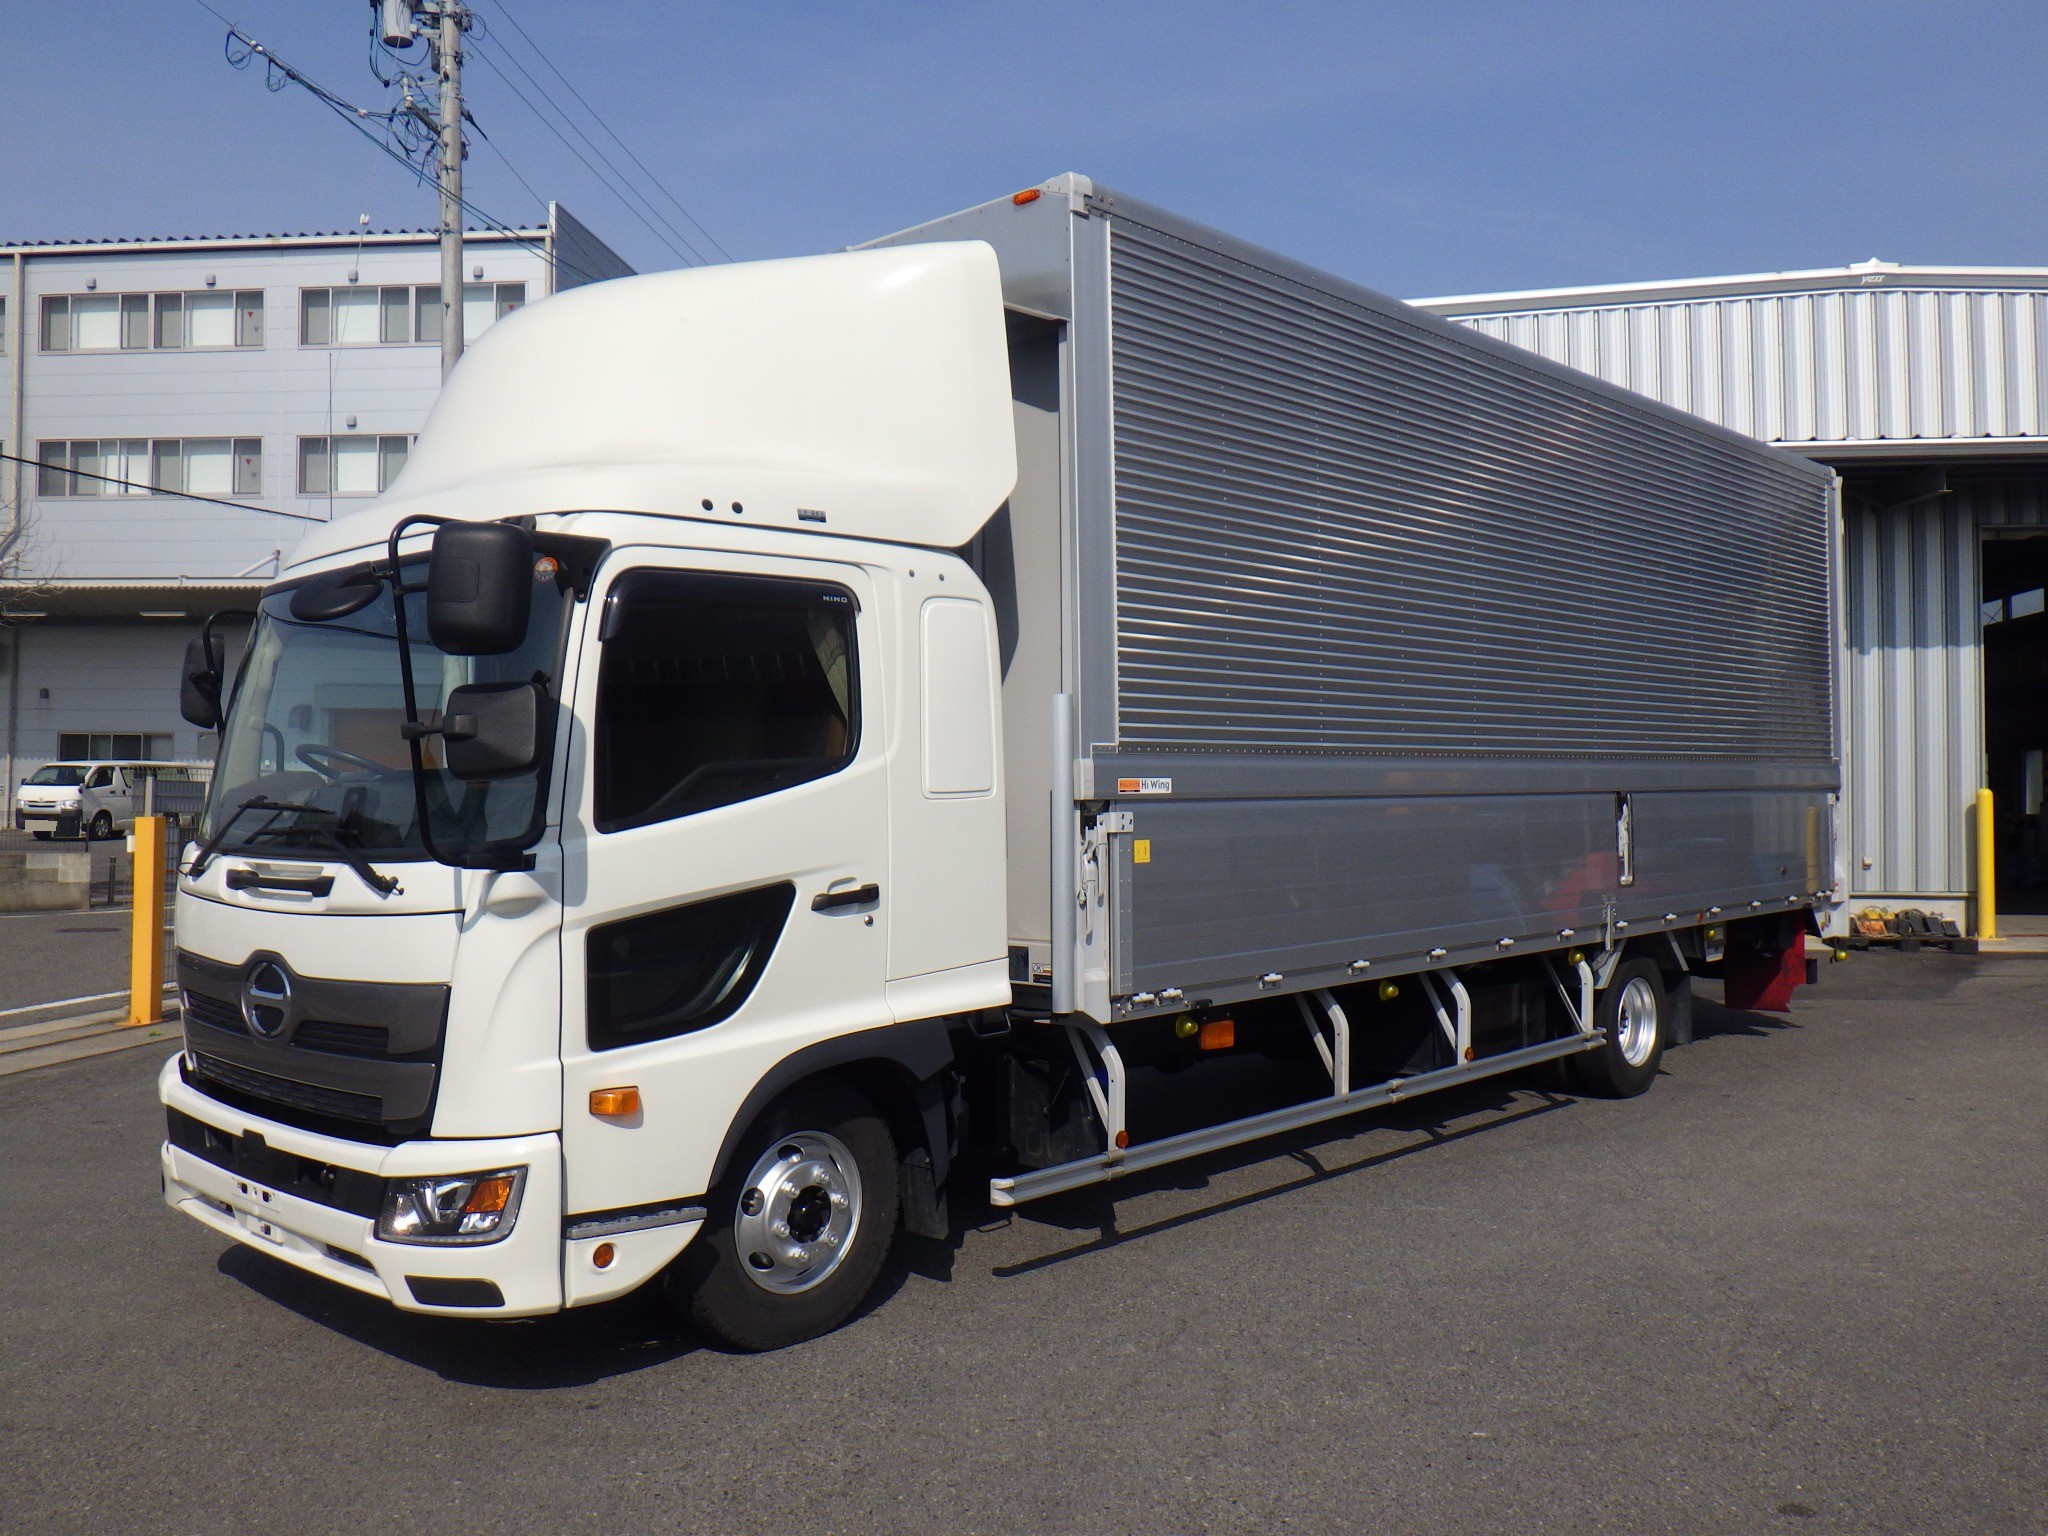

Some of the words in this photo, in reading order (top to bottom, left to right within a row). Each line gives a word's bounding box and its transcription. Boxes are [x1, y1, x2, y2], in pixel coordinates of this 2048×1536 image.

[822, 595, 848, 603] HINO
[1141, 779, 1149, 789] Hi
[1150, 779, 1170, 791] Wing
